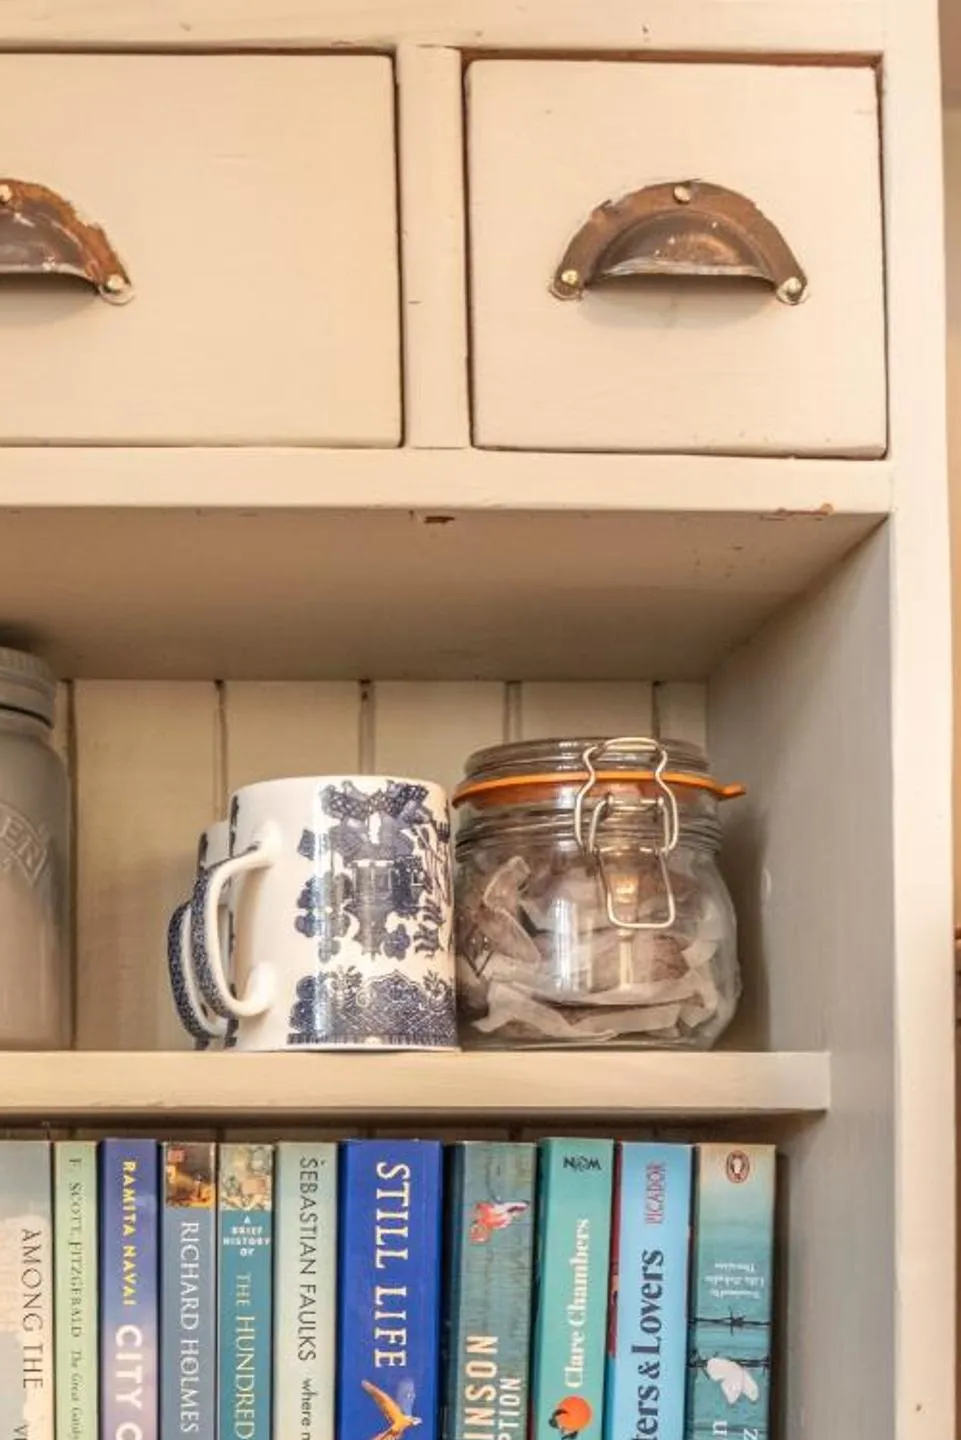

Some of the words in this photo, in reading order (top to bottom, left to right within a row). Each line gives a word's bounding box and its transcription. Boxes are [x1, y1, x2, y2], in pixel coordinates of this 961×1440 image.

[122, 1161, 137, 1237] RAMITA
[298, 1156, 318, 1274] SEBASTIAN
[374, 1161, 411, 1269] STILL
[643, 1162, 668, 1226] PICADOR
[21, 1228, 44, 1332] AMONG
[122, 1245, 137, 1306] NAVAI
[179, 1220, 200, 1331] RICHARD
[234, 1273, 252, 1307] THE
[564, 1218, 592, 1325] Chambers
[630, 1249, 665, 1355] Lovers
[297, 1284, 317, 1362] FAULKS
[372, 1286, 409, 1369] LIFE
[562, 1331, 588, 1389] Clare
[21, 1343, 44, 1390] THE
[113, 1324, 143, 1413] CITY
[179, 1338, 200, 1433] HOLMES
[234, 1315, 257, 1439] HUNDRED
[298, 1377, 317, 1427] where
[638, 1361, 657, 1380] &
